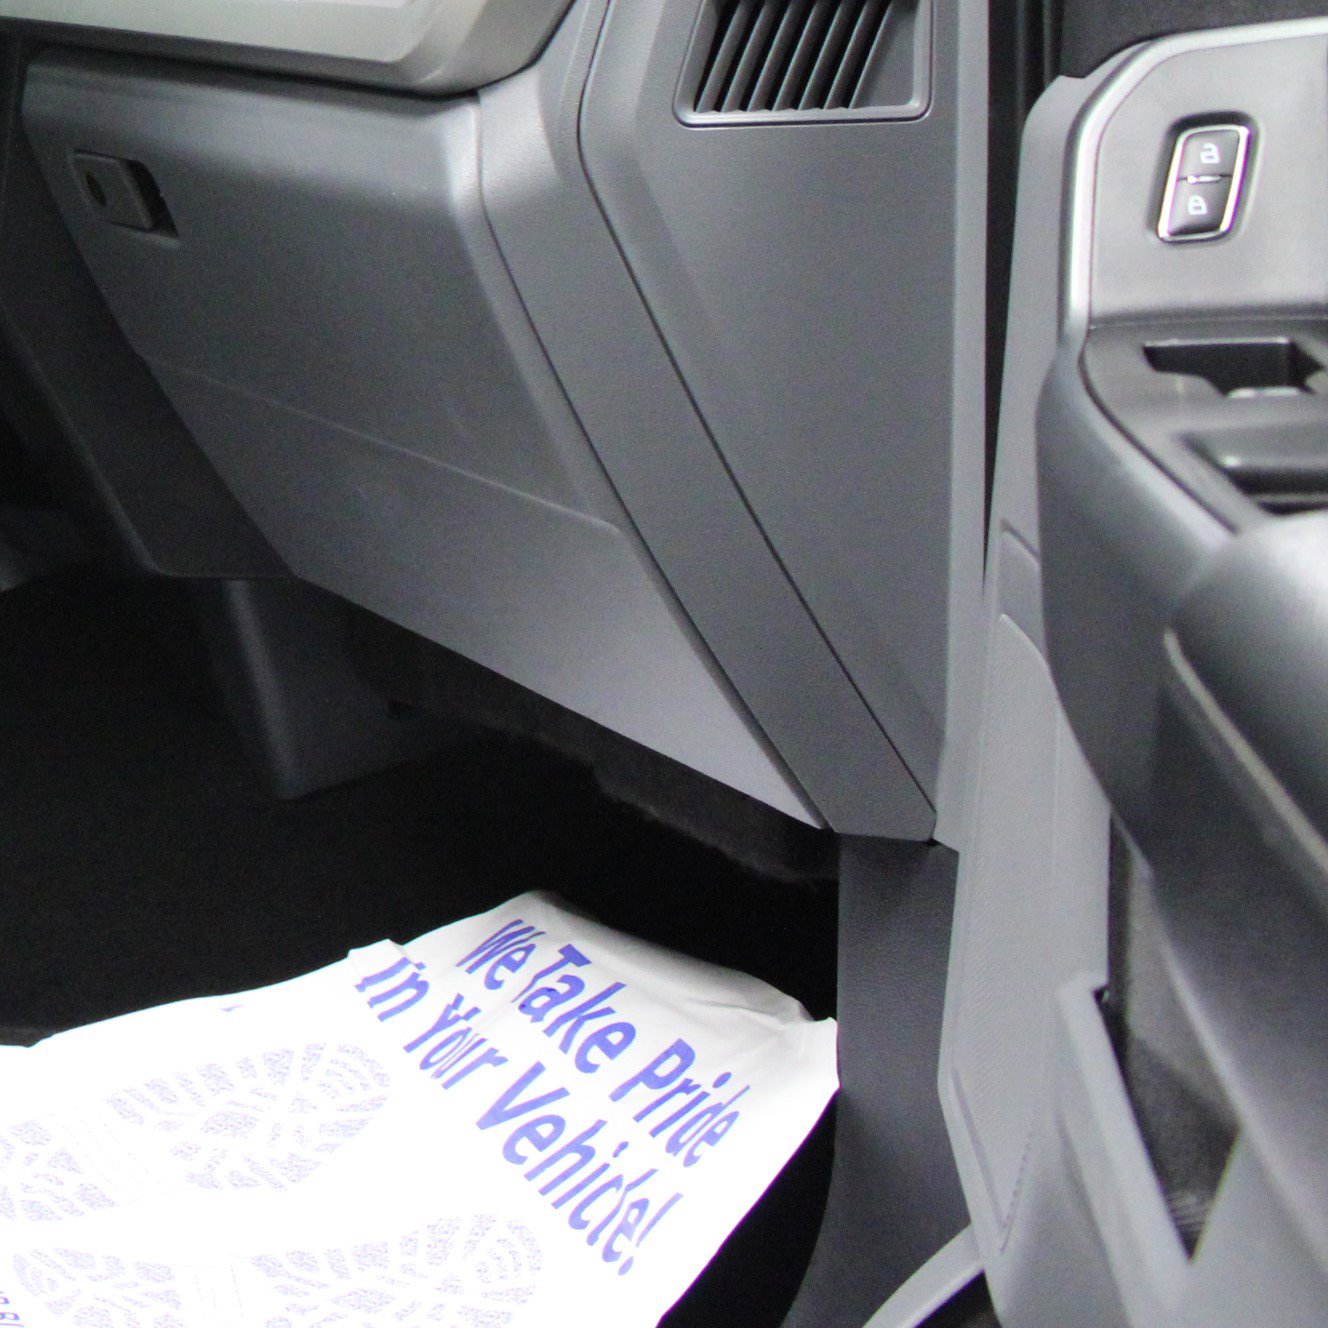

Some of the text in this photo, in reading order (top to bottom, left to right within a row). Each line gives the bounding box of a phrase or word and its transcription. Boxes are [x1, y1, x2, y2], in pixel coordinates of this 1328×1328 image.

[402, 993, 509, 1090] Your
[475, 1060, 684, 1276] Vehicle!
[455, 919, 751, 1168] We Take Pride
